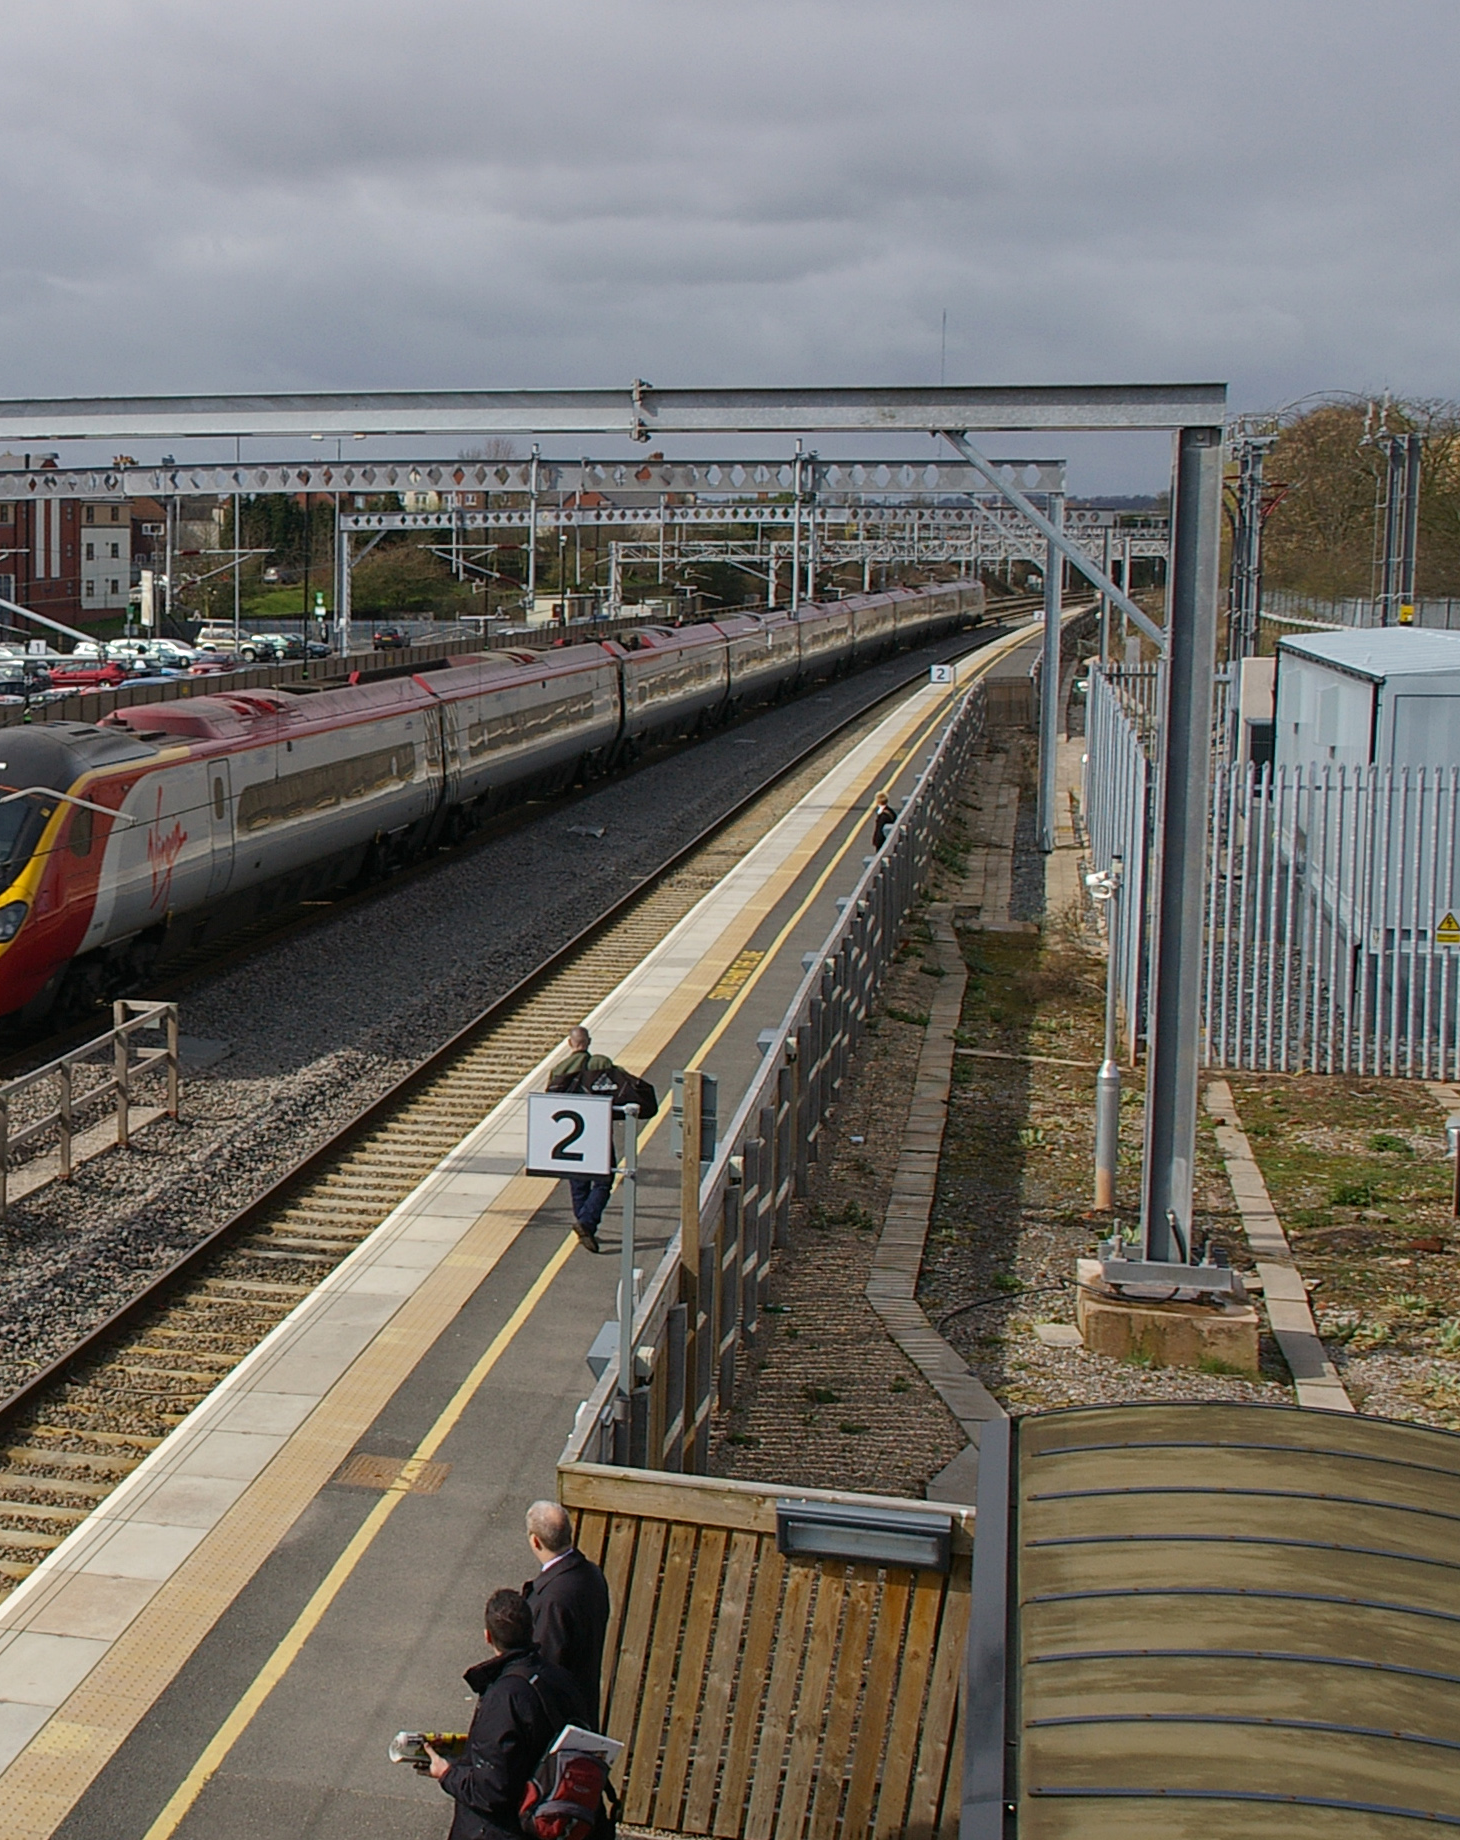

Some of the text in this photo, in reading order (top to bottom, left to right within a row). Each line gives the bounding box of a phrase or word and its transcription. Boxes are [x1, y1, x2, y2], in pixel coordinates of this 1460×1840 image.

[35, 642, 41, 653] 1
[936, 667, 945, 680] 2
[147, 785, 188, 913] Virgin
[551, 1110, 585, 1162] 2
